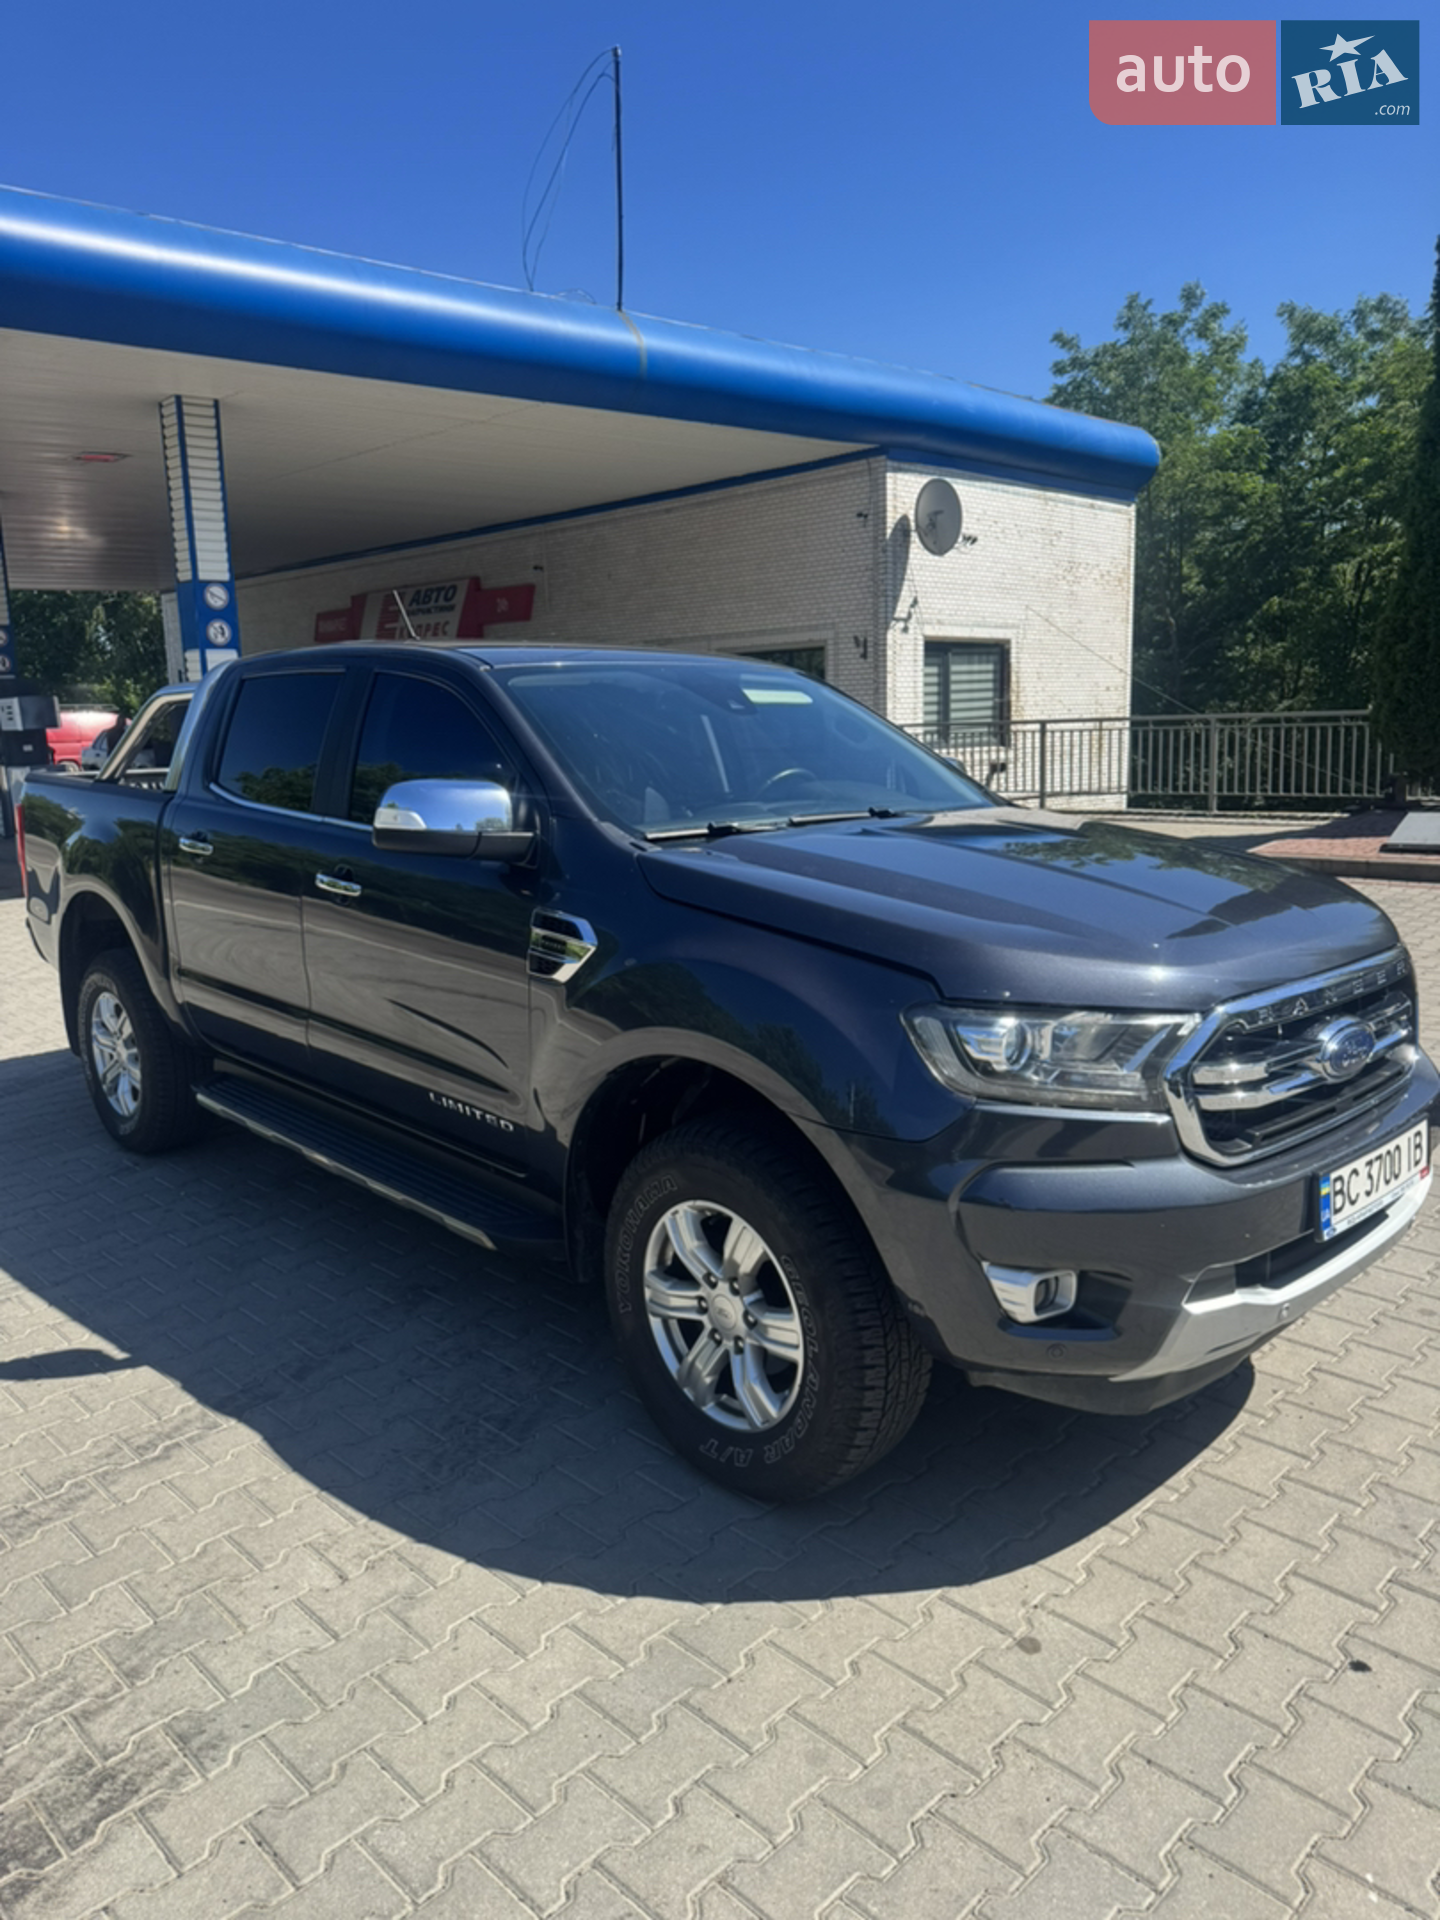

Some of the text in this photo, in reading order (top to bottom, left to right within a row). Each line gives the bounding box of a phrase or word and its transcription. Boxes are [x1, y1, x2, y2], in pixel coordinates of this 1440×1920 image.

[408, 584, 458, 607] АВТО
[428, 1091, 514, 1132] LIMITED
[1332, 1168, 1360, 1215] BC
[1364, 1144, 1402, 1198] 3700
[1407, 1130, 1424, 1172] IB
[615, 1174, 678, 1314] YOKOHAMA
